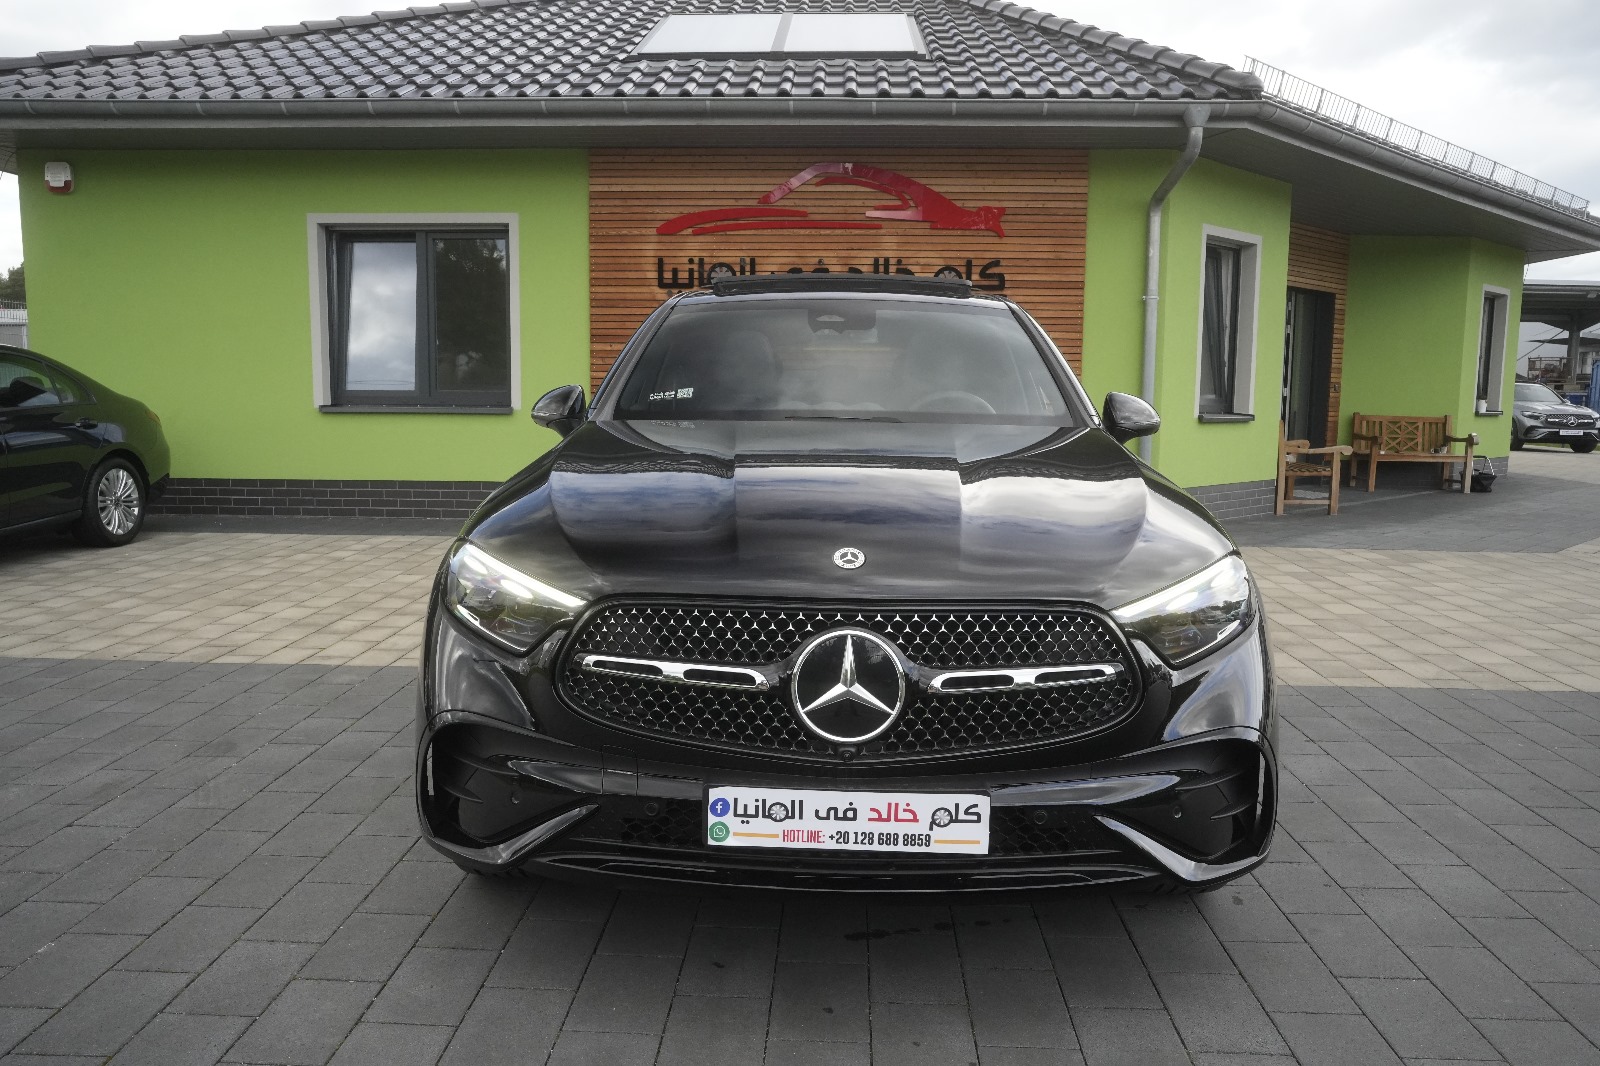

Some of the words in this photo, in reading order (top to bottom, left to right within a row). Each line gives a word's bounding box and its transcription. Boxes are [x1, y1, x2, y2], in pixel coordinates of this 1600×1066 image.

[733, 798, 804, 825] المانيا
[868, 803, 919, 823] خالد
[782, 829, 826, 844] HOTLINE:
[828, 831, 850, 845] +20
[852, 831, 875, 845] 128
[877, 832, 900, 847] 688
[902, 833, 932, 847] 8859
